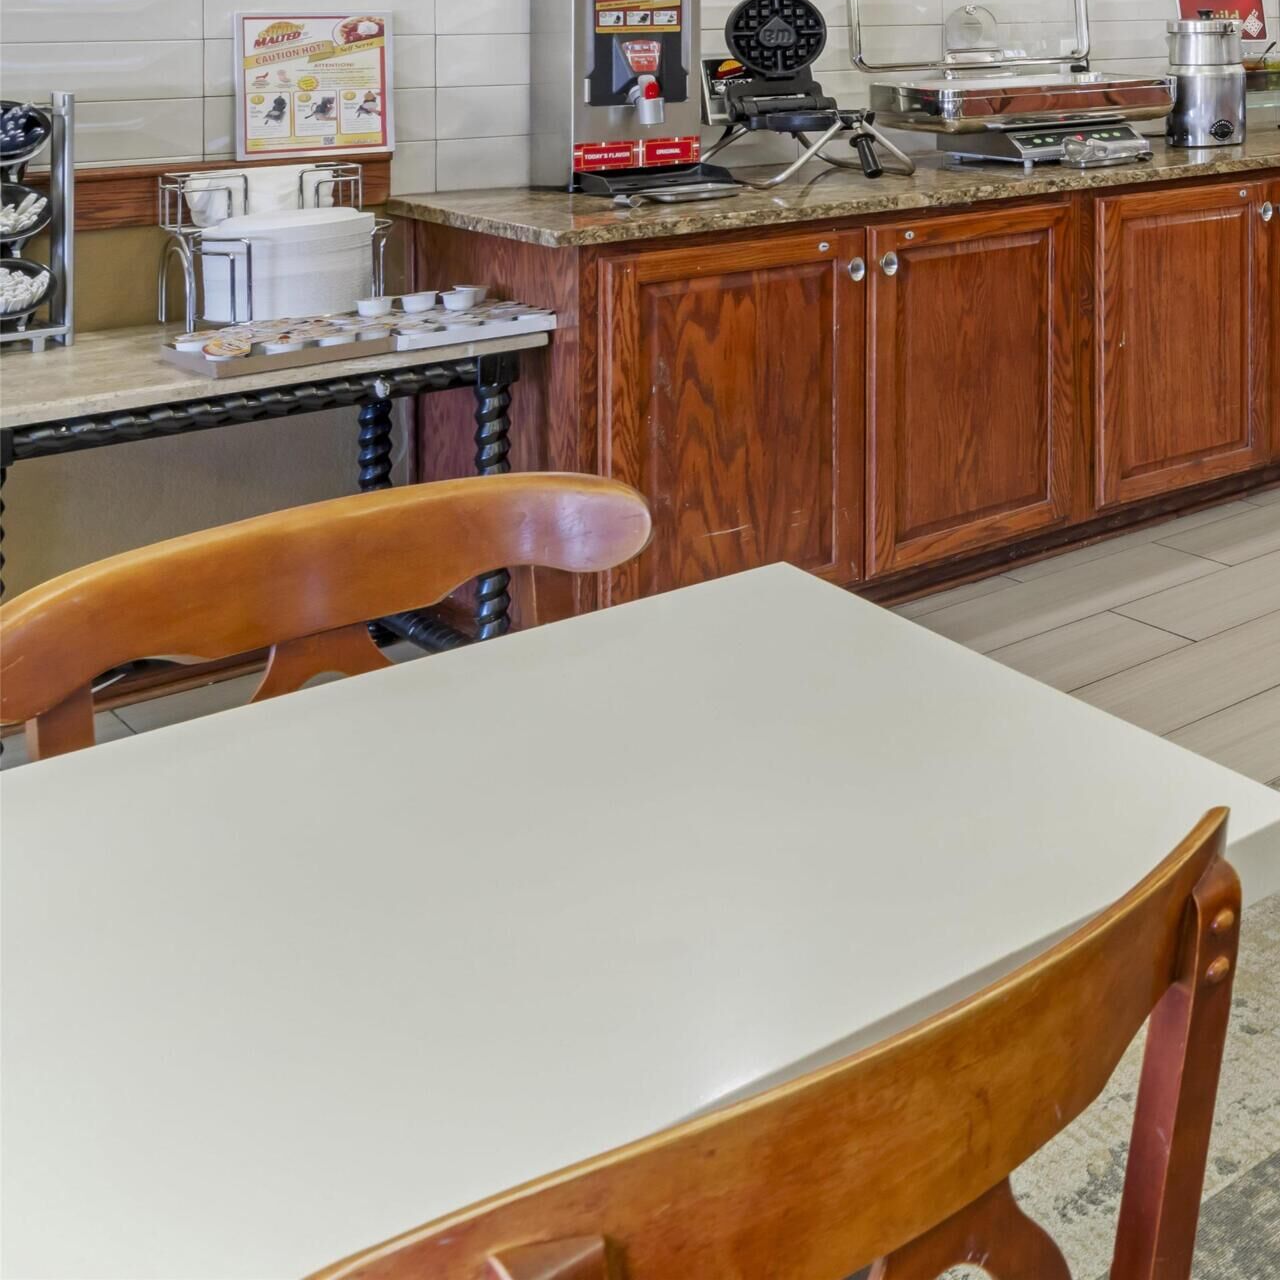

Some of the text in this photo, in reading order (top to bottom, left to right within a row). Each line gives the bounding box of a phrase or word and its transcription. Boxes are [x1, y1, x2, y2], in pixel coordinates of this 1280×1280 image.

[254, 32, 301, 48] MALTED
[256, 43, 325, 65] CAUTION HOT!
